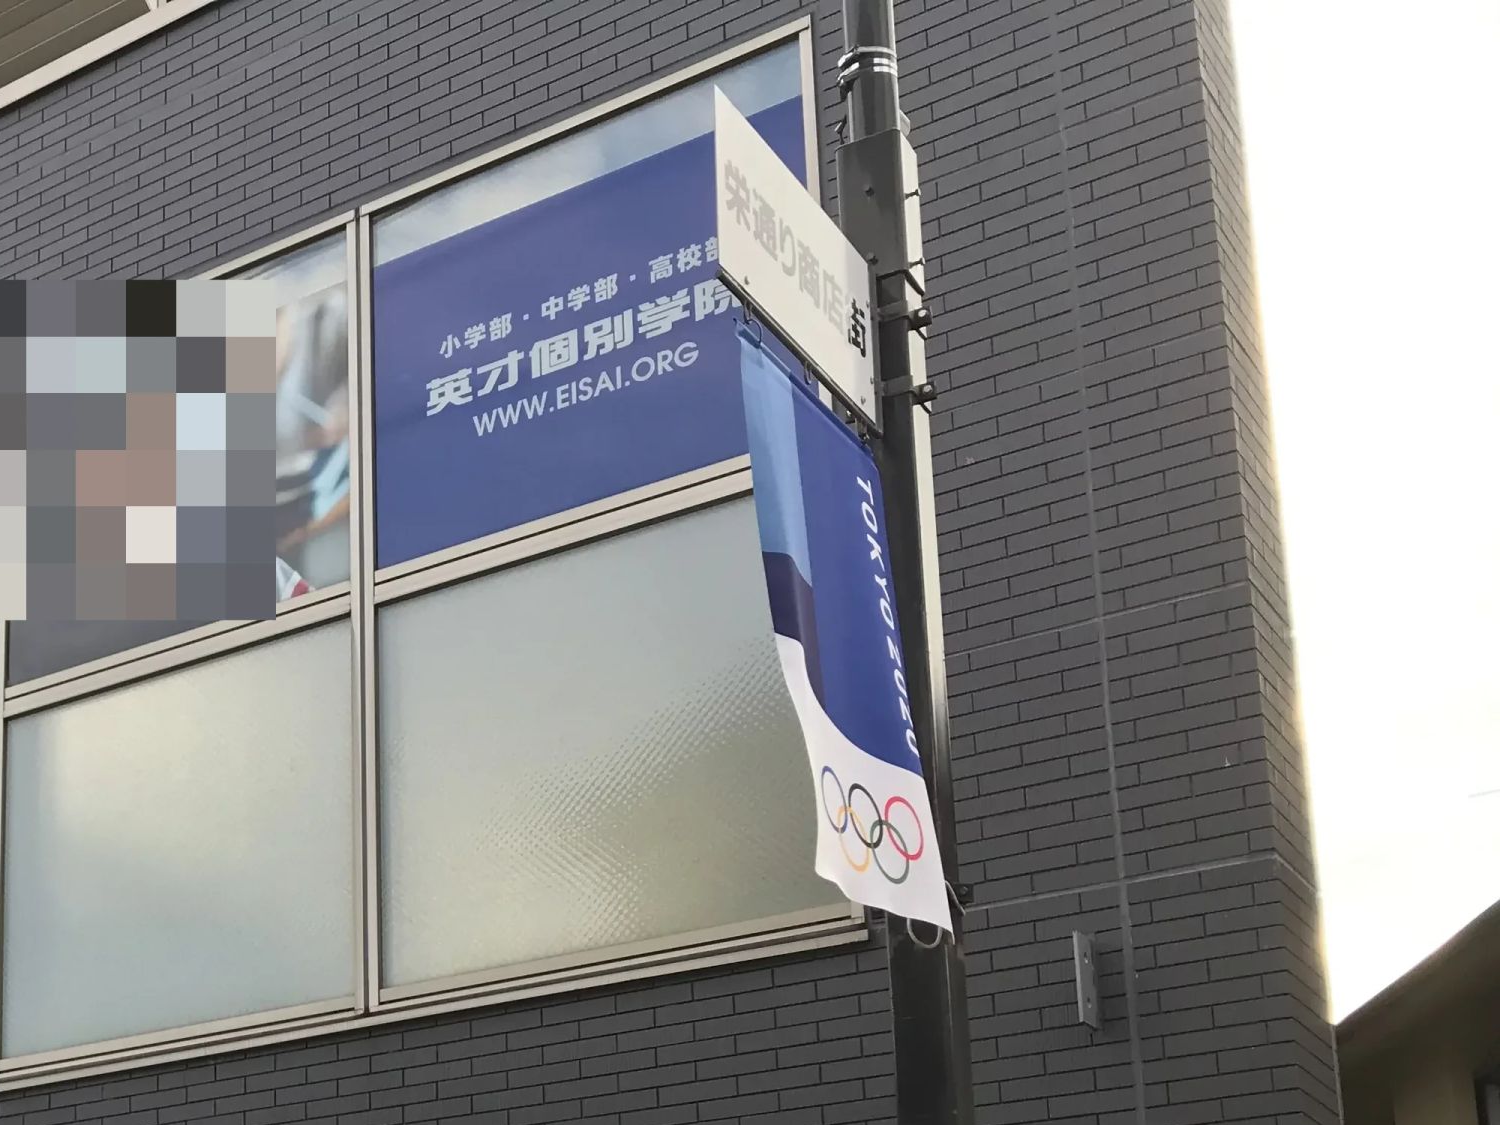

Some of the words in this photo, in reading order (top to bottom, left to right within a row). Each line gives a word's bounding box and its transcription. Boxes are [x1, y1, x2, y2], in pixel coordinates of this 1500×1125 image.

[724, 160, 867, 360] 栄通り商店街
[425, 279, 742, 416] 英才個別学院
[472, 341, 700, 437] WWW.EISAI.ORG
[856, 475, 893, 633] TOKYO
[886, 638, 920, 760] 2020
